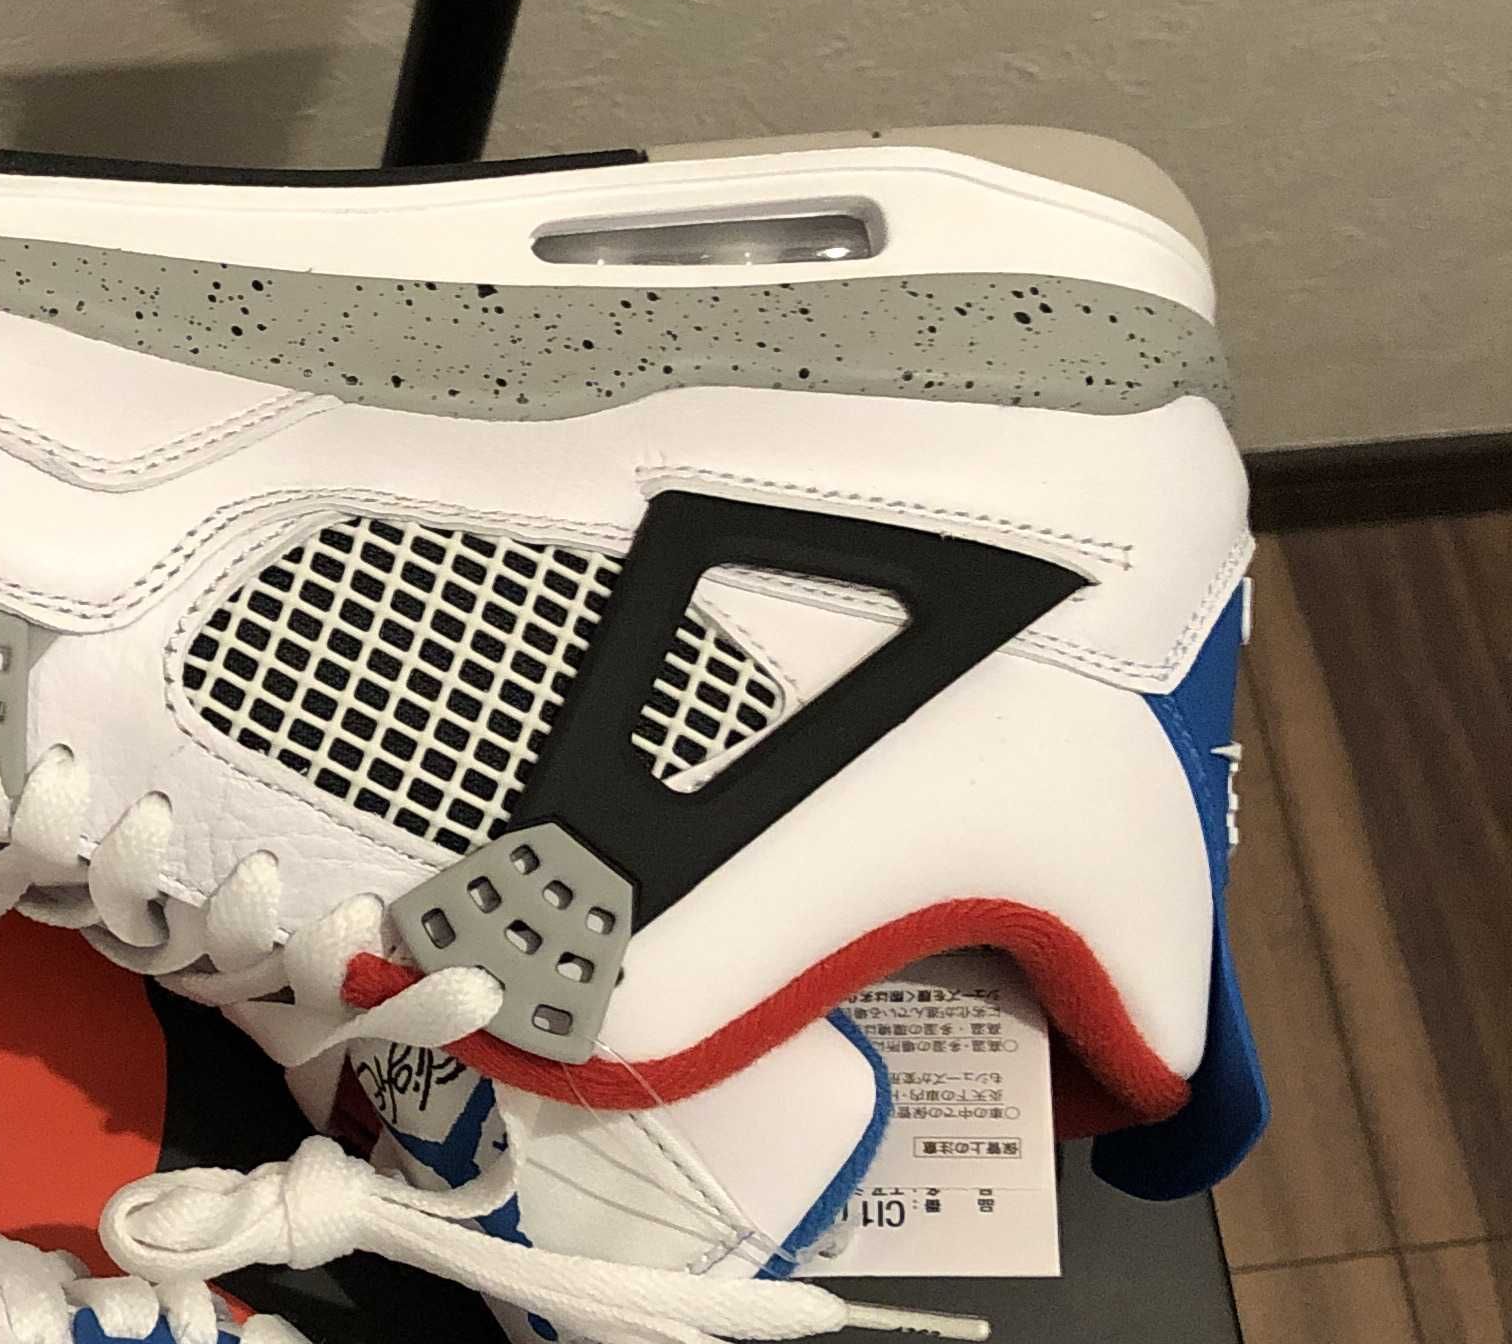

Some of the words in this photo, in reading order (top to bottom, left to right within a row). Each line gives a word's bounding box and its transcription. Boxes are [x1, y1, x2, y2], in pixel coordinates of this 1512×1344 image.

[923, 1141, 1019, 1155] 保管上の注意
